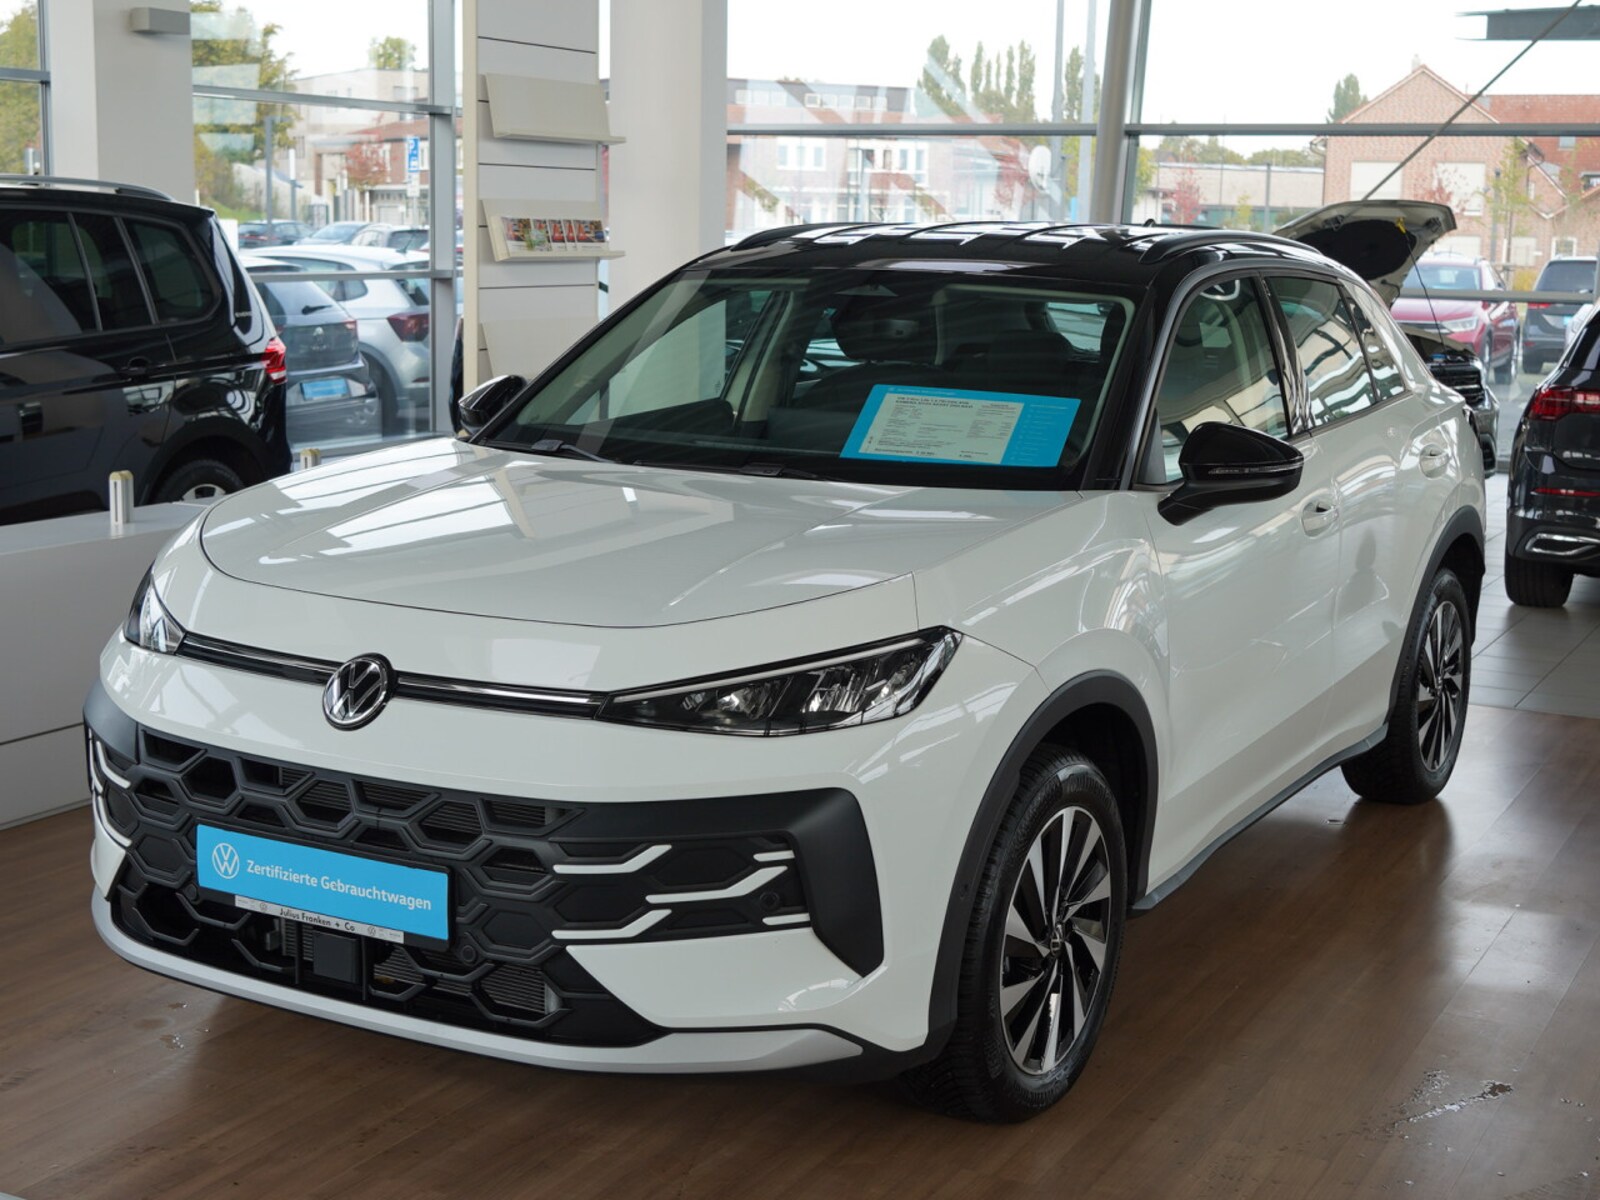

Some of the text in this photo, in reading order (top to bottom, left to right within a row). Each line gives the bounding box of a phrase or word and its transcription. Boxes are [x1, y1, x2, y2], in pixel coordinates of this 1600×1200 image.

[211, 842, 240, 879] VW
[246, 860, 432, 911] Zertifizierte Gebrauchtwagen
[279, 908, 300, 920] Julius
[301, 913, 331, 926] Franken
[344, 922, 356, 932] Co
